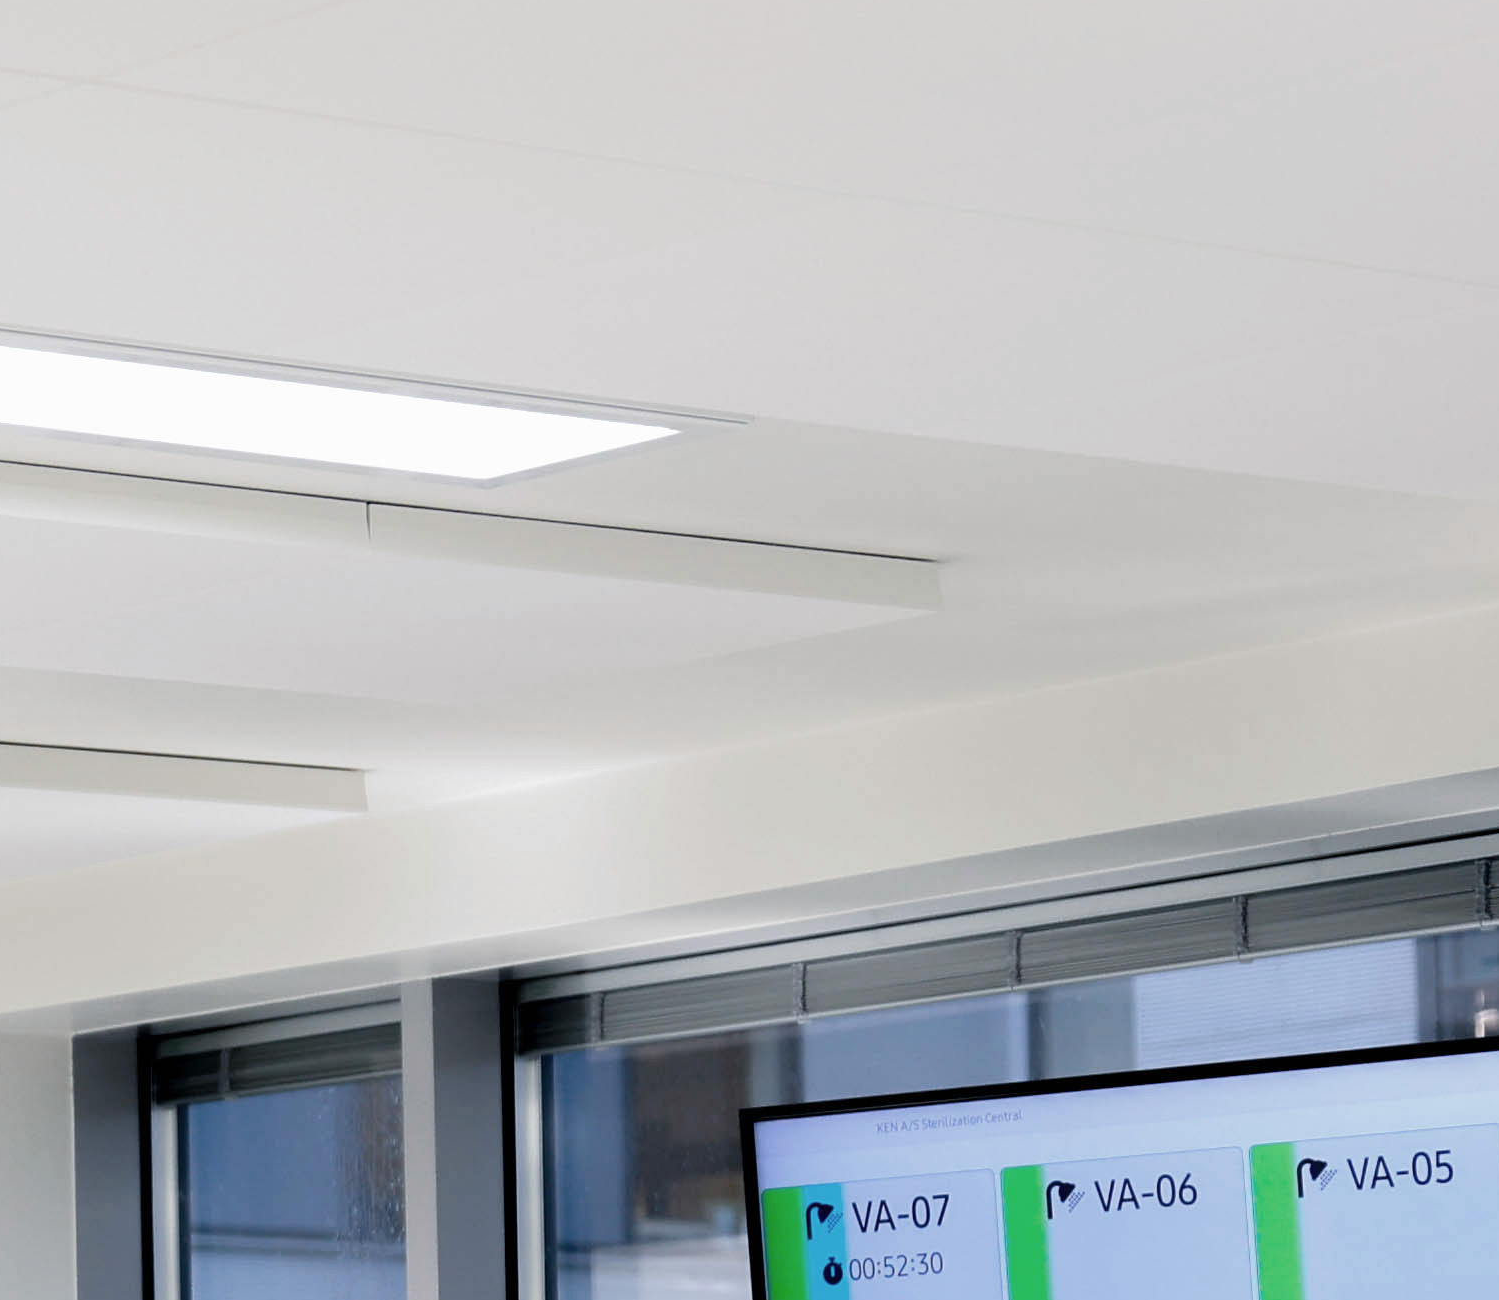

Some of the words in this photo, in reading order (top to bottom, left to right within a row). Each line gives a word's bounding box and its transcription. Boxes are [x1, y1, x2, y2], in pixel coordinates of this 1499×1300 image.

[876, 1121, 898, 1133] KEN
[901, 1119, 919, 1131] A/S
[921, 1114, 983, 1130] Sterilization
[984, 1109, 1023, 1124] Central
[1346, 1150, 1455, 1191] VA-05
[1094, 1173, 1198, 1213] VA-06
[852, 1194, 950, 1234] VA-07
[848, 1251, 944, 1282] 00:52:30
